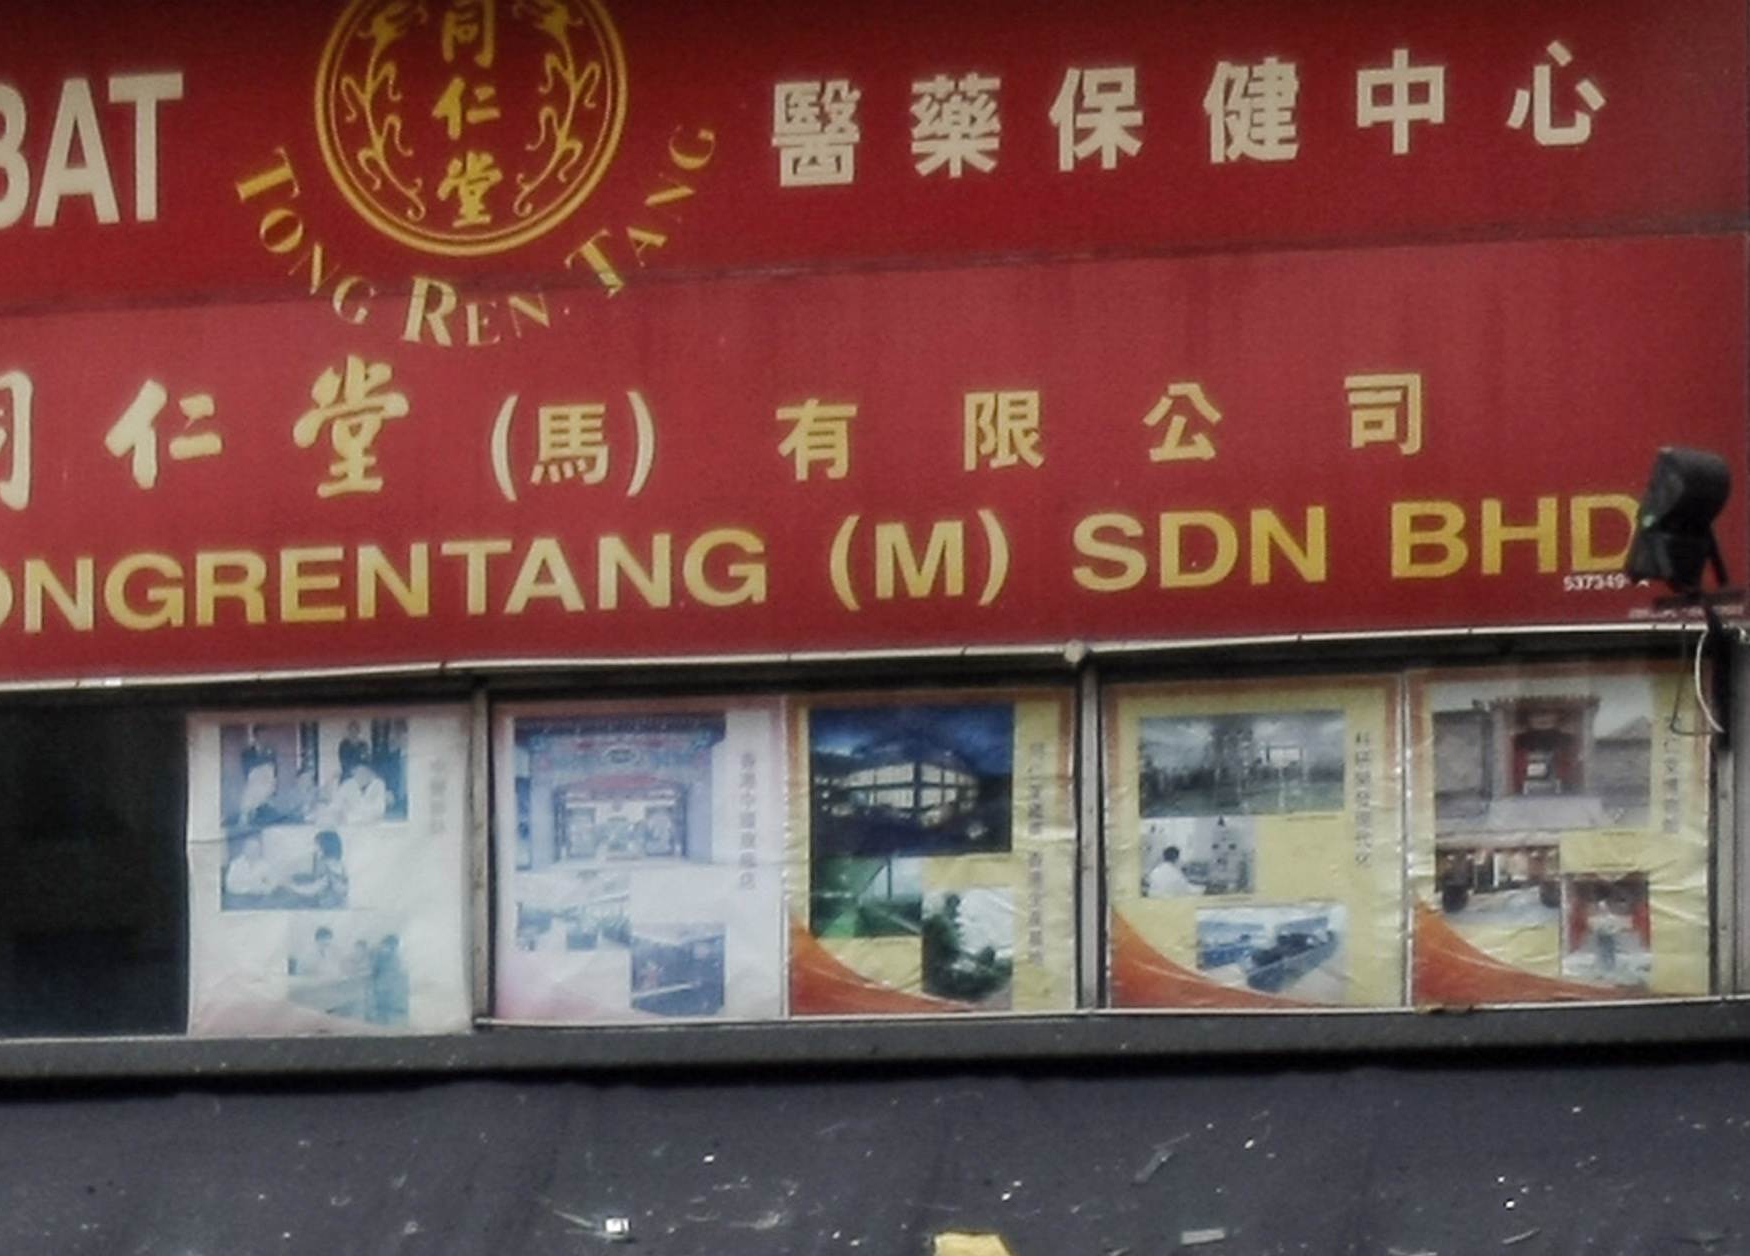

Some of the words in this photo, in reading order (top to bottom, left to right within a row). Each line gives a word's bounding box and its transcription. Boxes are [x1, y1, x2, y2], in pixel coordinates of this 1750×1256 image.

[236, 146, 377, 325] TONG
[402, 274, 551, 347] REN
[564, 127, 716, 298] TANG
[828, 509, 1009, 610] (M)
[1071, 506, 1326, 592] SDN
[1390, 493, 1639, 580] BHD
